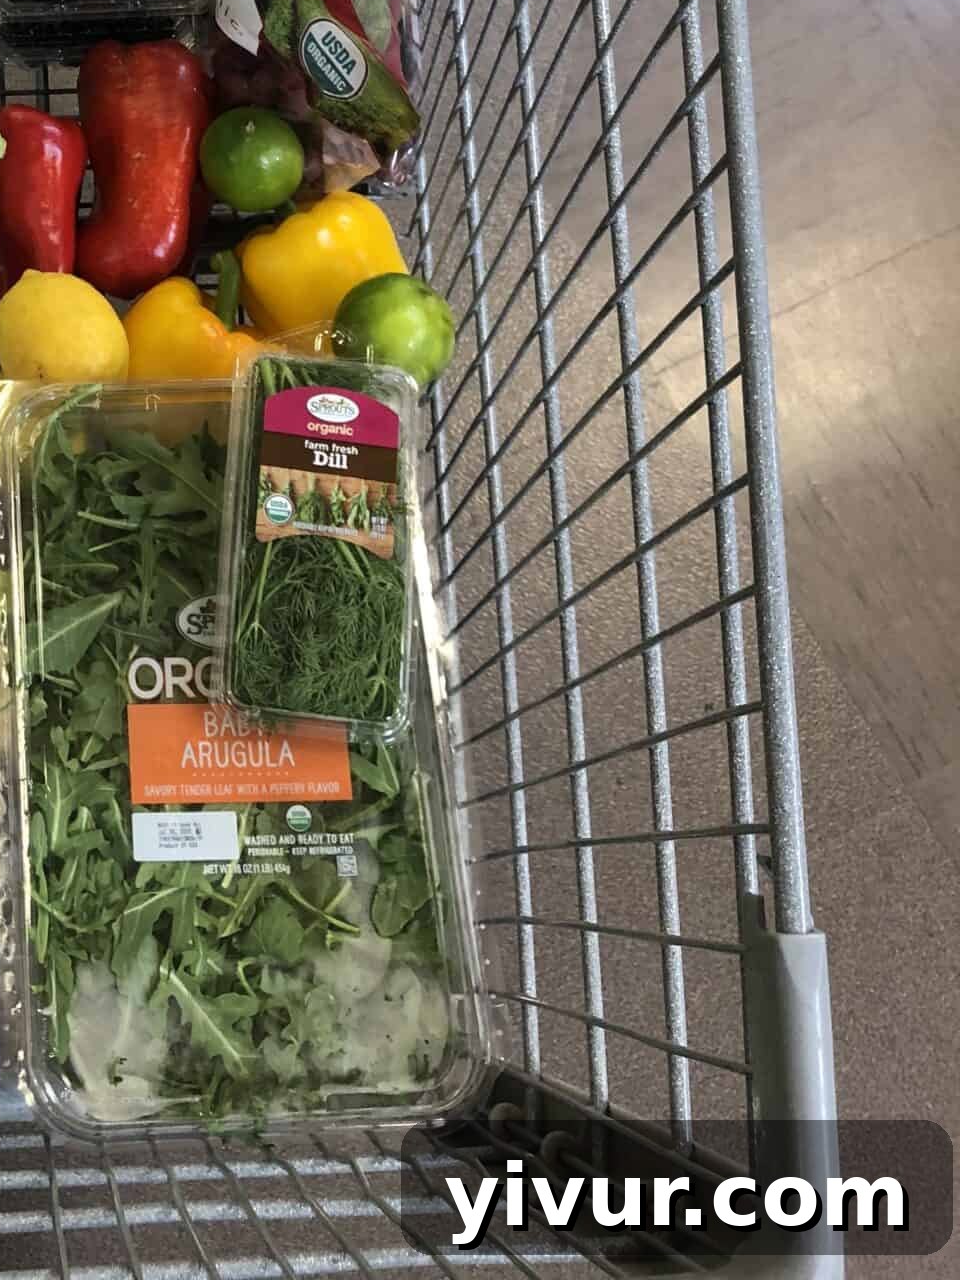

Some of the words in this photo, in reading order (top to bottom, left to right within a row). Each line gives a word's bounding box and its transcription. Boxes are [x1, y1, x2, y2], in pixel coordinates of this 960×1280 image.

[321, 30, 356, 75] USDA
[307, 41, 346, 91] ORGANIC
[307, 421, 354, 436] organic
[304, 439, 329, 451] farm
[331, 442, 359, 456] fresh
[312, 451, 349, 470] Dill
[180, 741, 296, 769] ARUGULA
[279, 834, 296, 845] AND
[326, 833, 338, 844] TO
[340, 833, 354, 844] EAT
[203, 864, 218, 874] NET
